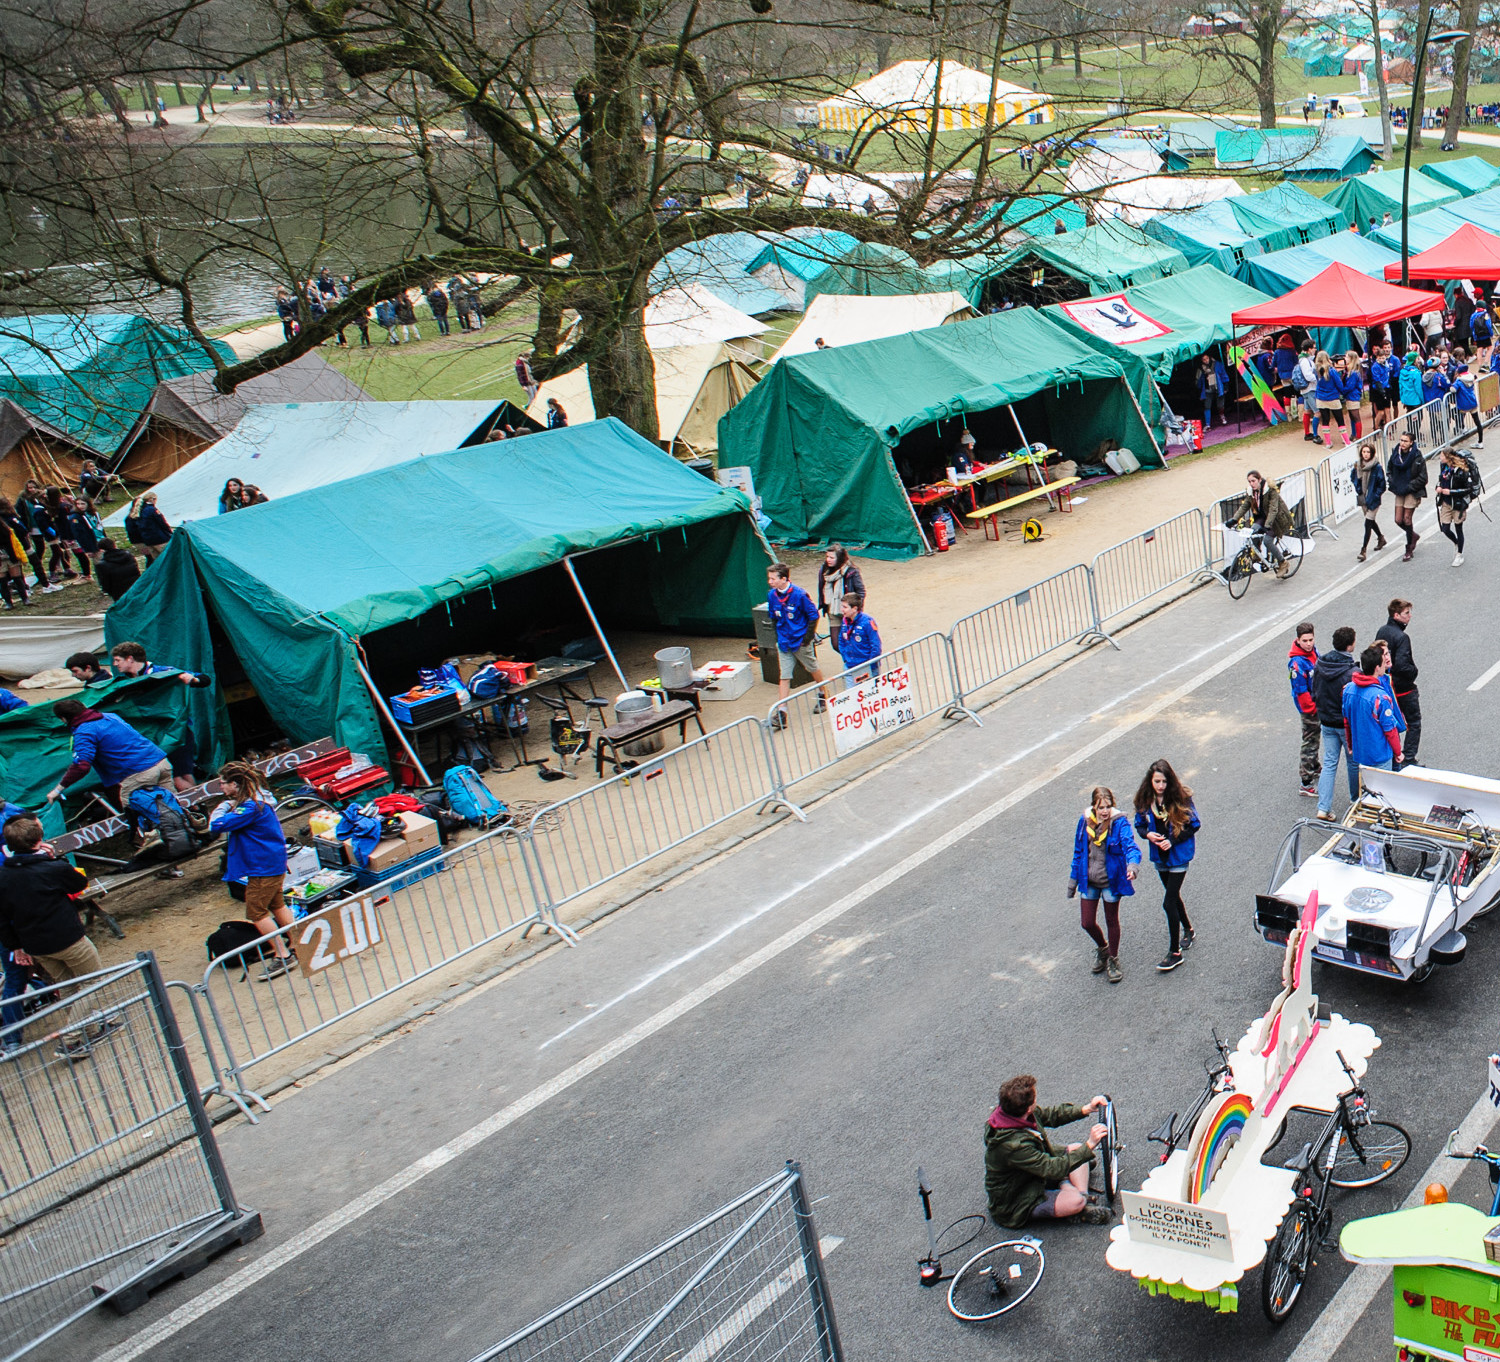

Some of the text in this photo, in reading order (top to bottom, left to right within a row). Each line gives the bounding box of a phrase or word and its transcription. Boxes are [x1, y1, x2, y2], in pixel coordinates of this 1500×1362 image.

[836, 697, 888, 731] Enghien
[299, 896, 381, 972] 2.01
[1139, 1207, 1213, 1231] LICORNES
[1148, 1202, 1161, 1210] UN
[1188, 1210, 1203, 1219] LES
[1129, 1214, 1183, 1231] DOMINERONT
[1196, 1228, 1227, 1240] MONDE
[1141, 1223, 1161, 1232] MAIS
[1162, 1228, 1177, 1236] PAS
[1431, 1296, 1496, 1330] BIKE
